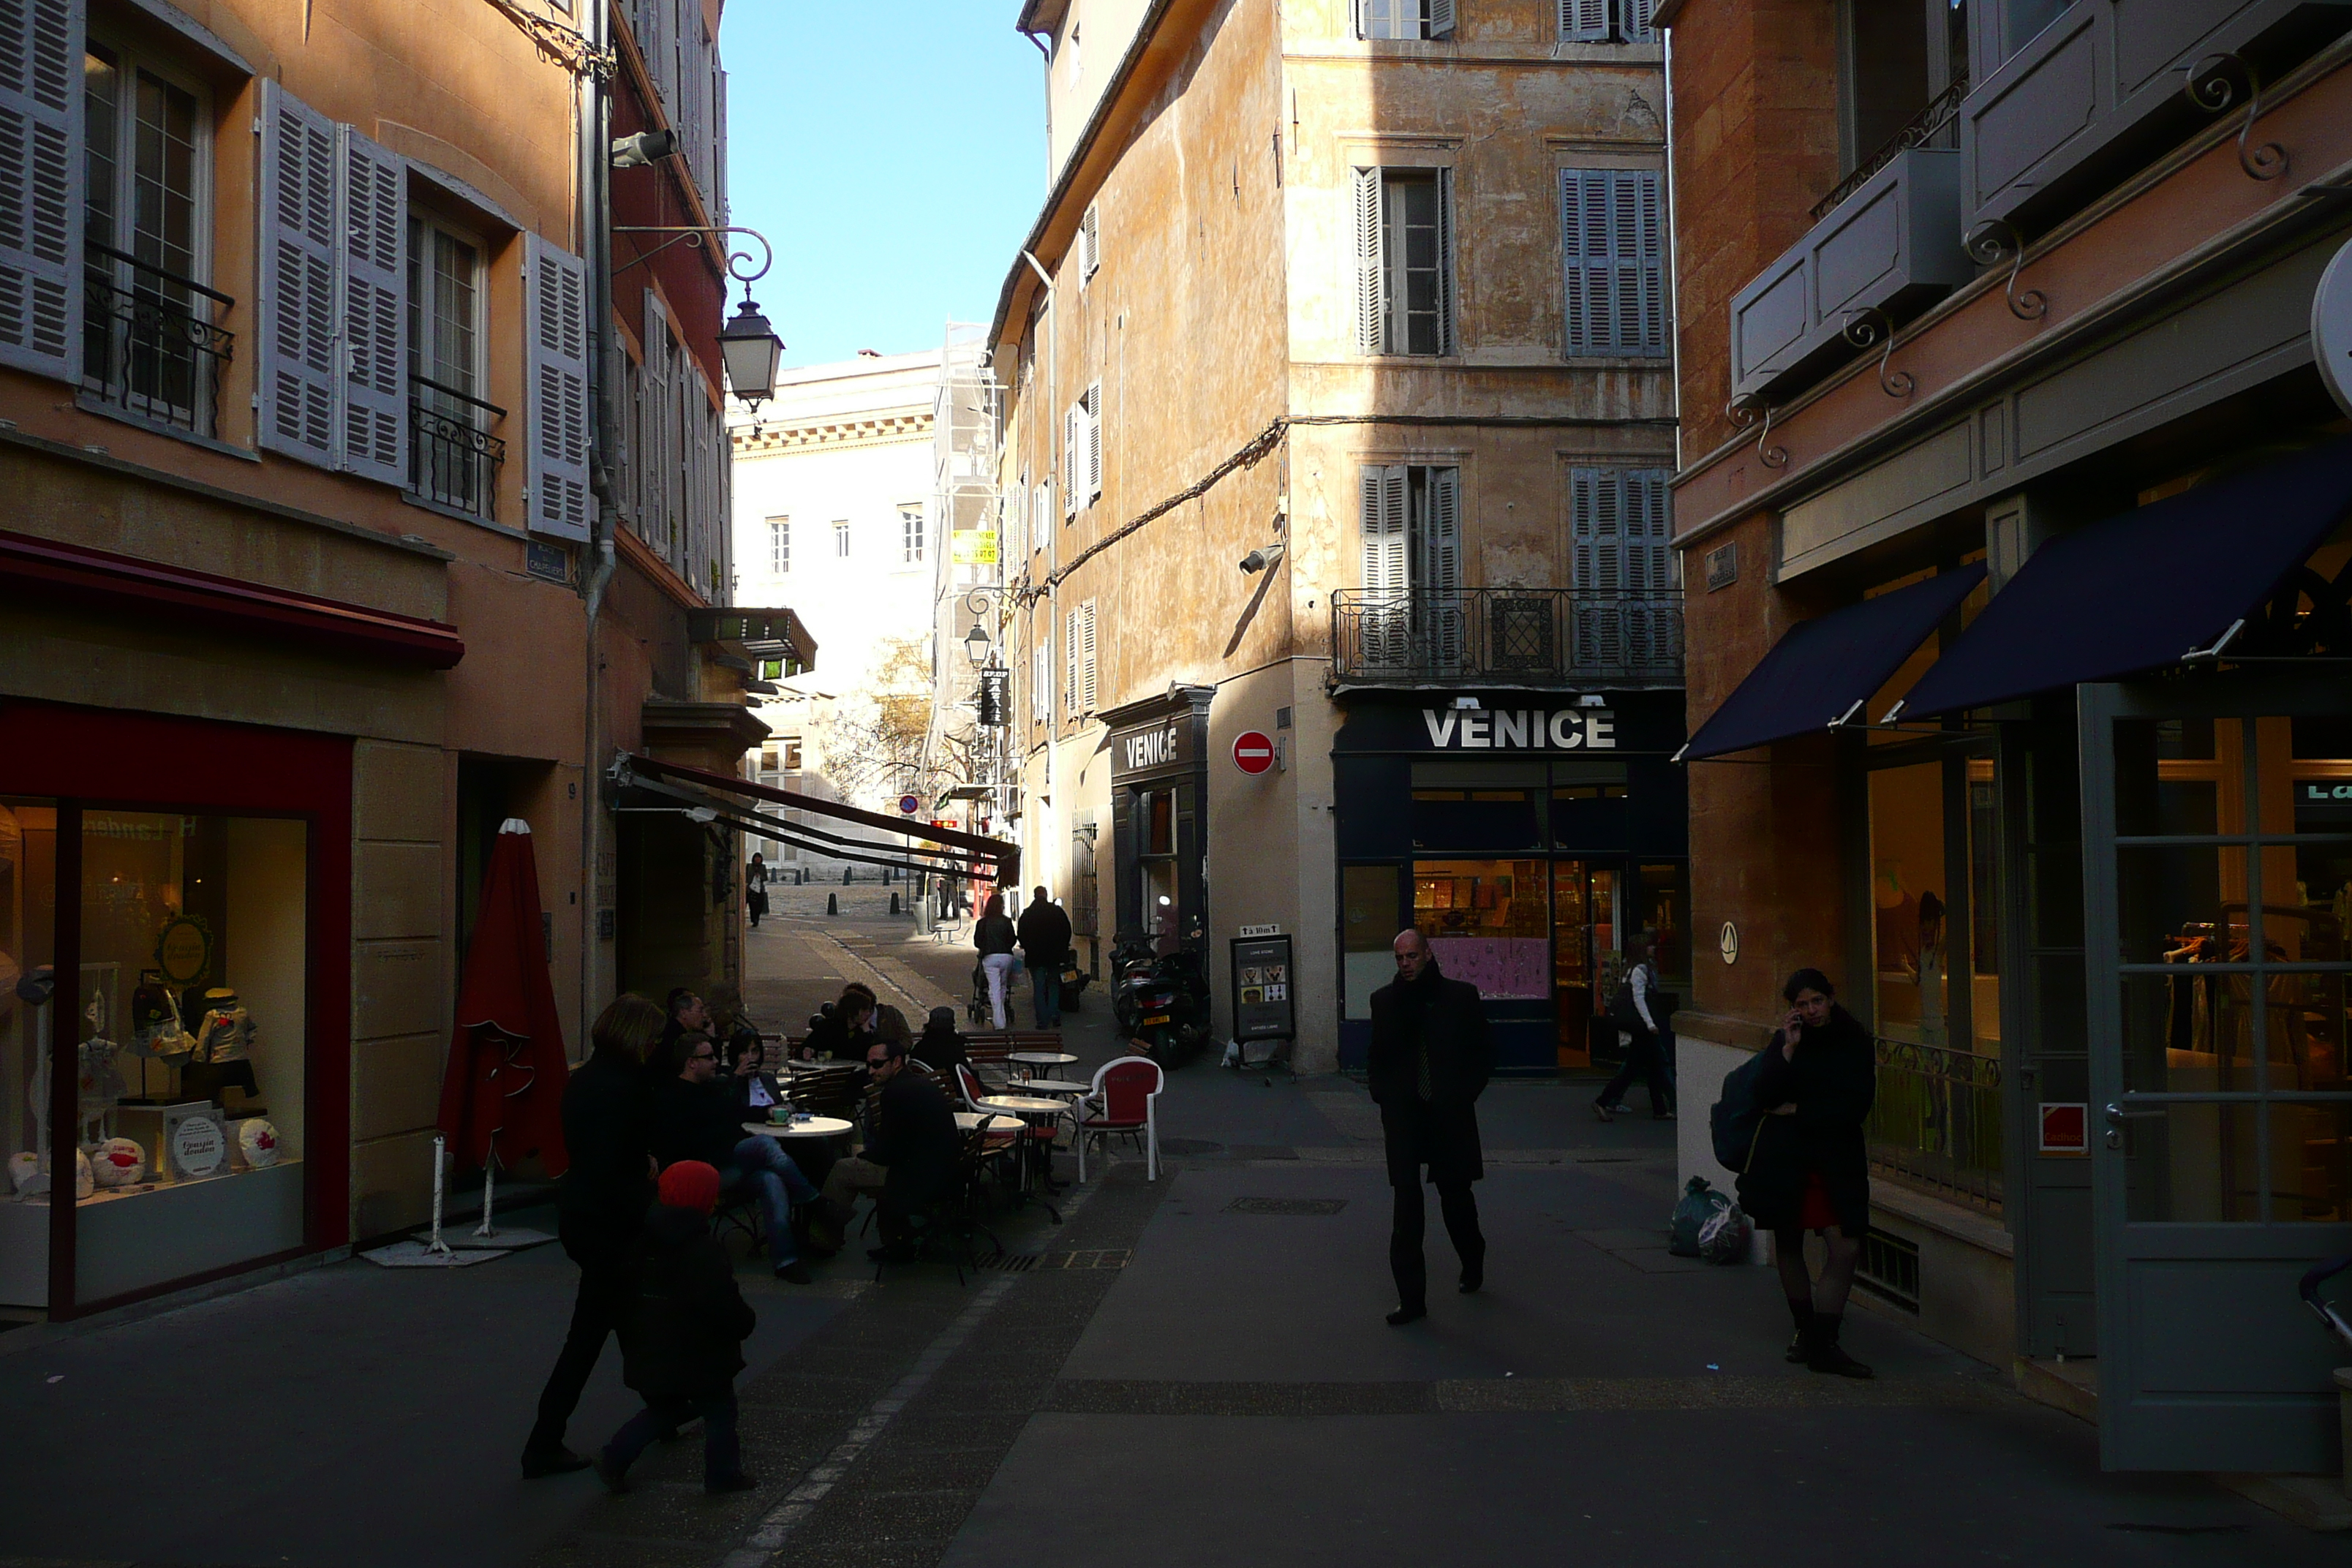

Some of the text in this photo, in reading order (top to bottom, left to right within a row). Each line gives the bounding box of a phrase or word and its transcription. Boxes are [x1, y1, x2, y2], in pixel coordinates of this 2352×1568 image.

[980, 550, 987, 559] 07
[529, 559, 564, 577] CHAPELIERS
[1422, 708, 1616, 749] VENICE
[1126, 727, 1177, 769] VENICE
[2044, 1132, 2082, 1142] Cadhoc
